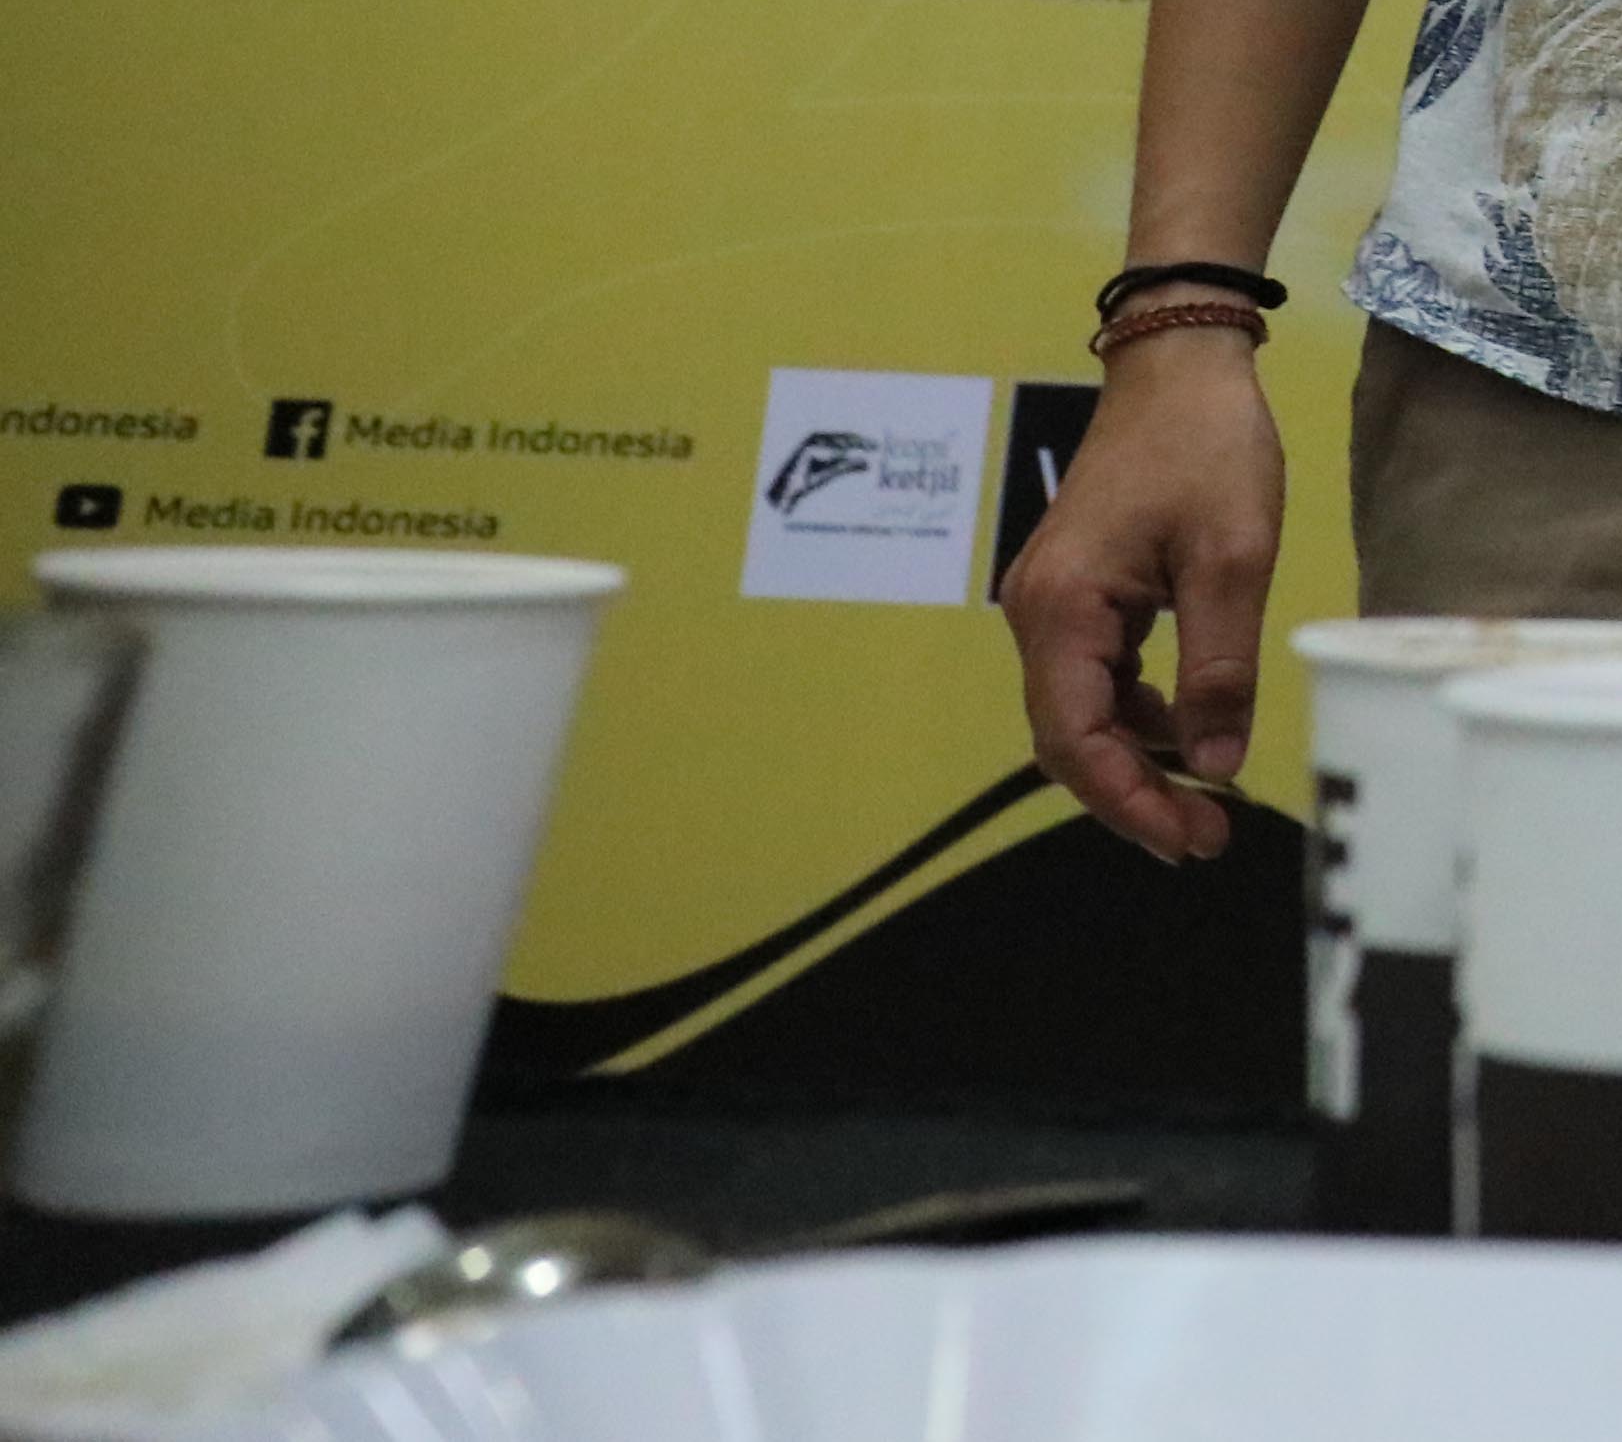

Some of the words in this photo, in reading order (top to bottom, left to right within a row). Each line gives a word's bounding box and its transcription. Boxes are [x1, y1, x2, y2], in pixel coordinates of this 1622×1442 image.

[345, 413, 474, 451] Media
[489, 421, 694, 459] Indonesia
[144, 493, 275, 532] Media
[290, 499, 500, 537] Indonesia
